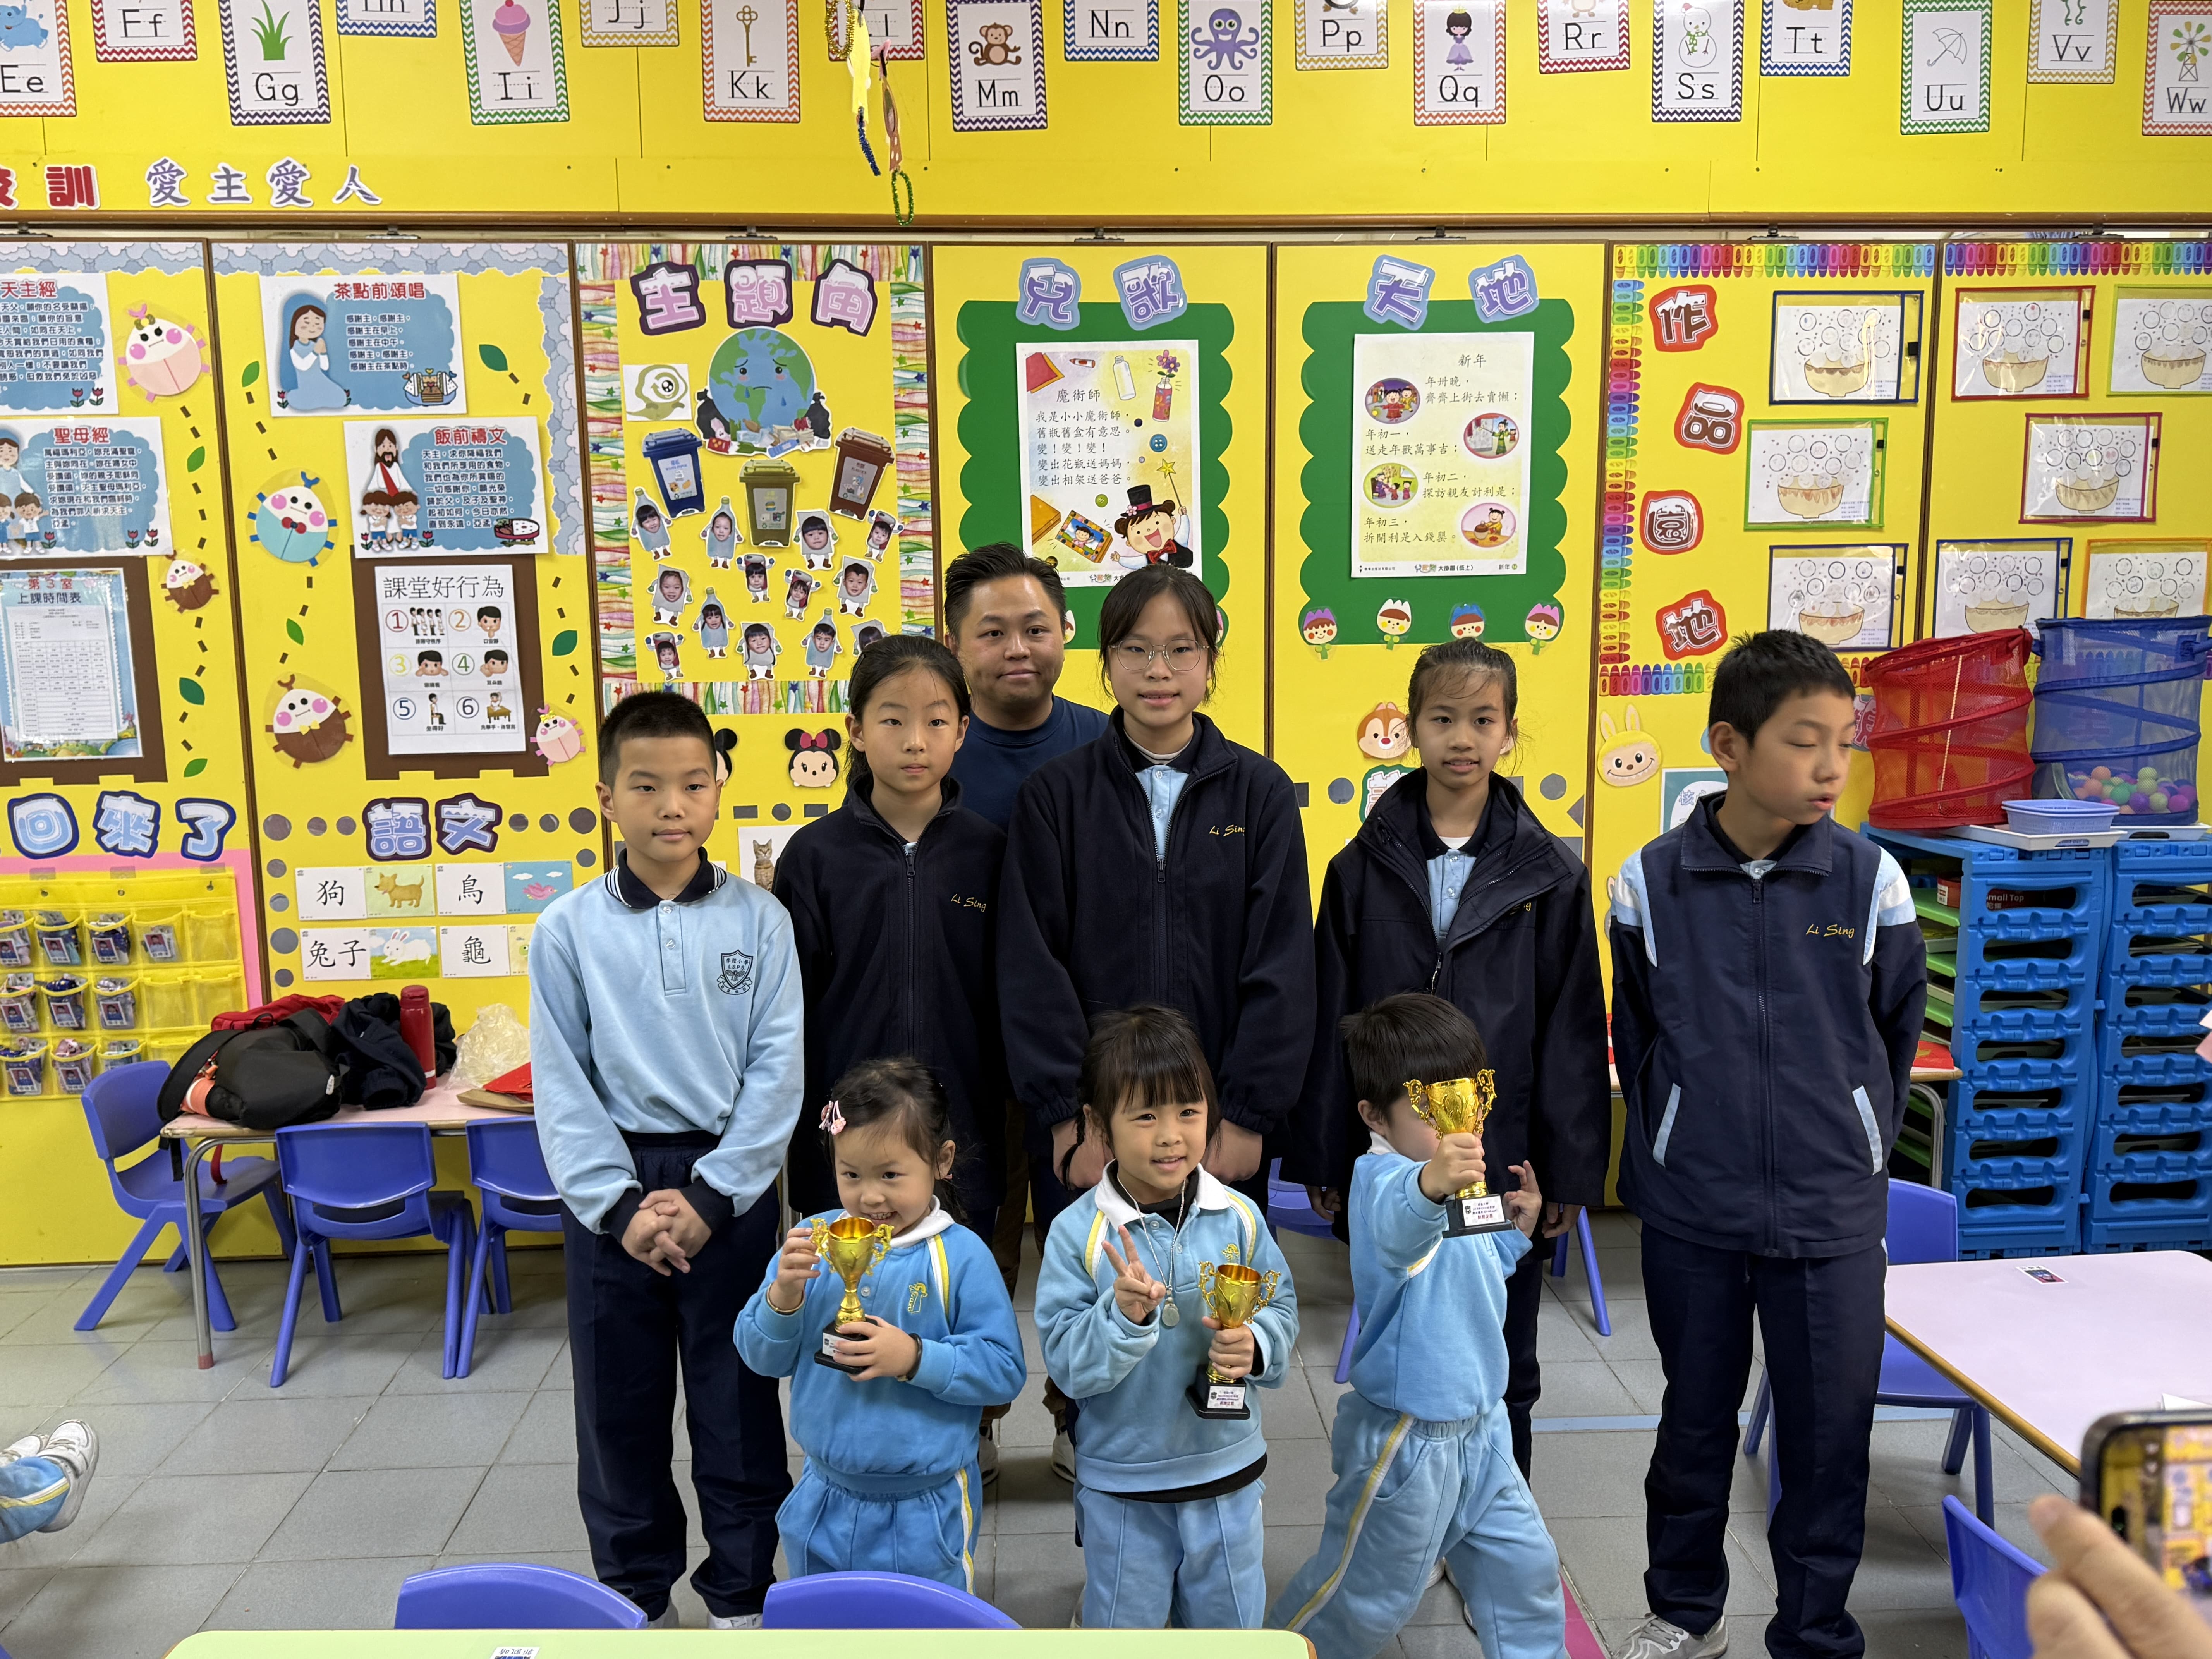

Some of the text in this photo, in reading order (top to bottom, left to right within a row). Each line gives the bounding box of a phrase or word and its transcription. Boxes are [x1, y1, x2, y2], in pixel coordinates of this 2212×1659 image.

[122, 9, 164, 38] Ff
[1091, 10, 1129, 38] Nn
[1322, 19, 1362, 52] Pp
[1564, 22, 1602, 50] Rr
[1785, 26, 1823, 54] Tt
[2052, 35, 2091, 62] Vv
[1, 65, 45, 93] Ee
[255, 72, 300, 106] Gg
[498, 72, 532, 100] Ii
[731, 71, 770, 99] Kk
[1439, 75, 1479, 108] Qq
[1677, 73, 1715, 100] Ss
[978, 79, 1019, 107] Mm
[1926, 84, 1964, 111] Uu
[2167, 87, 2208, 113] Ww
[147, 159, 380, 205] 愛主愛人
[1, 281, 57, 298] 天主經
[334, 283, 424, 299] 茶點前頌唱
[638, 263, 871, 333] 主題角
[1023, 262, 1180, 322] 兒歌
[1372, 259, 1534, 322] 天地
[1458, 354, 1486, 368] 新年
[1425, 376, 1468, 387] 年卅晚，
[1056, 389, 1101, 403] 魔術師
[1036, 411, 1128, 422] 我是小小魔術師，
[55, 428, 109, 443] 聖母經
[434, 428, 507, 445] 飯前禱文
[1037, 426, 1130, 438] 舊瓶舊盒有意思。
[1365, 428, 1409, 438] 年初一，
[1037, 442, 1105, 455] 變！變！變！
[1038, 458, 1130, 471] 變出花瓶送媽媽，
[1423, 471, 1467, 482] 年初二，
[1038, 474, 1130, 487] 變出相架送爸爸。
[1364, 517, 1408, 528] 年初三，
[17, 592, 81, 604] 上課時間表
[383, 576, 503, 599] 課堂好行為
[14, 795, 229, 856] 回來了
[368, 799, 495, 856] 語文
[1209, 825, 1219, 835] Li
[316, 880, 344, 906] 狗
[458, 874, 484, 905] 鳥
[1806, 924, 1855, 939] Li Sing
[306, 940, 367, 968] 兔子
[462, 936, 491, 965] 龜
